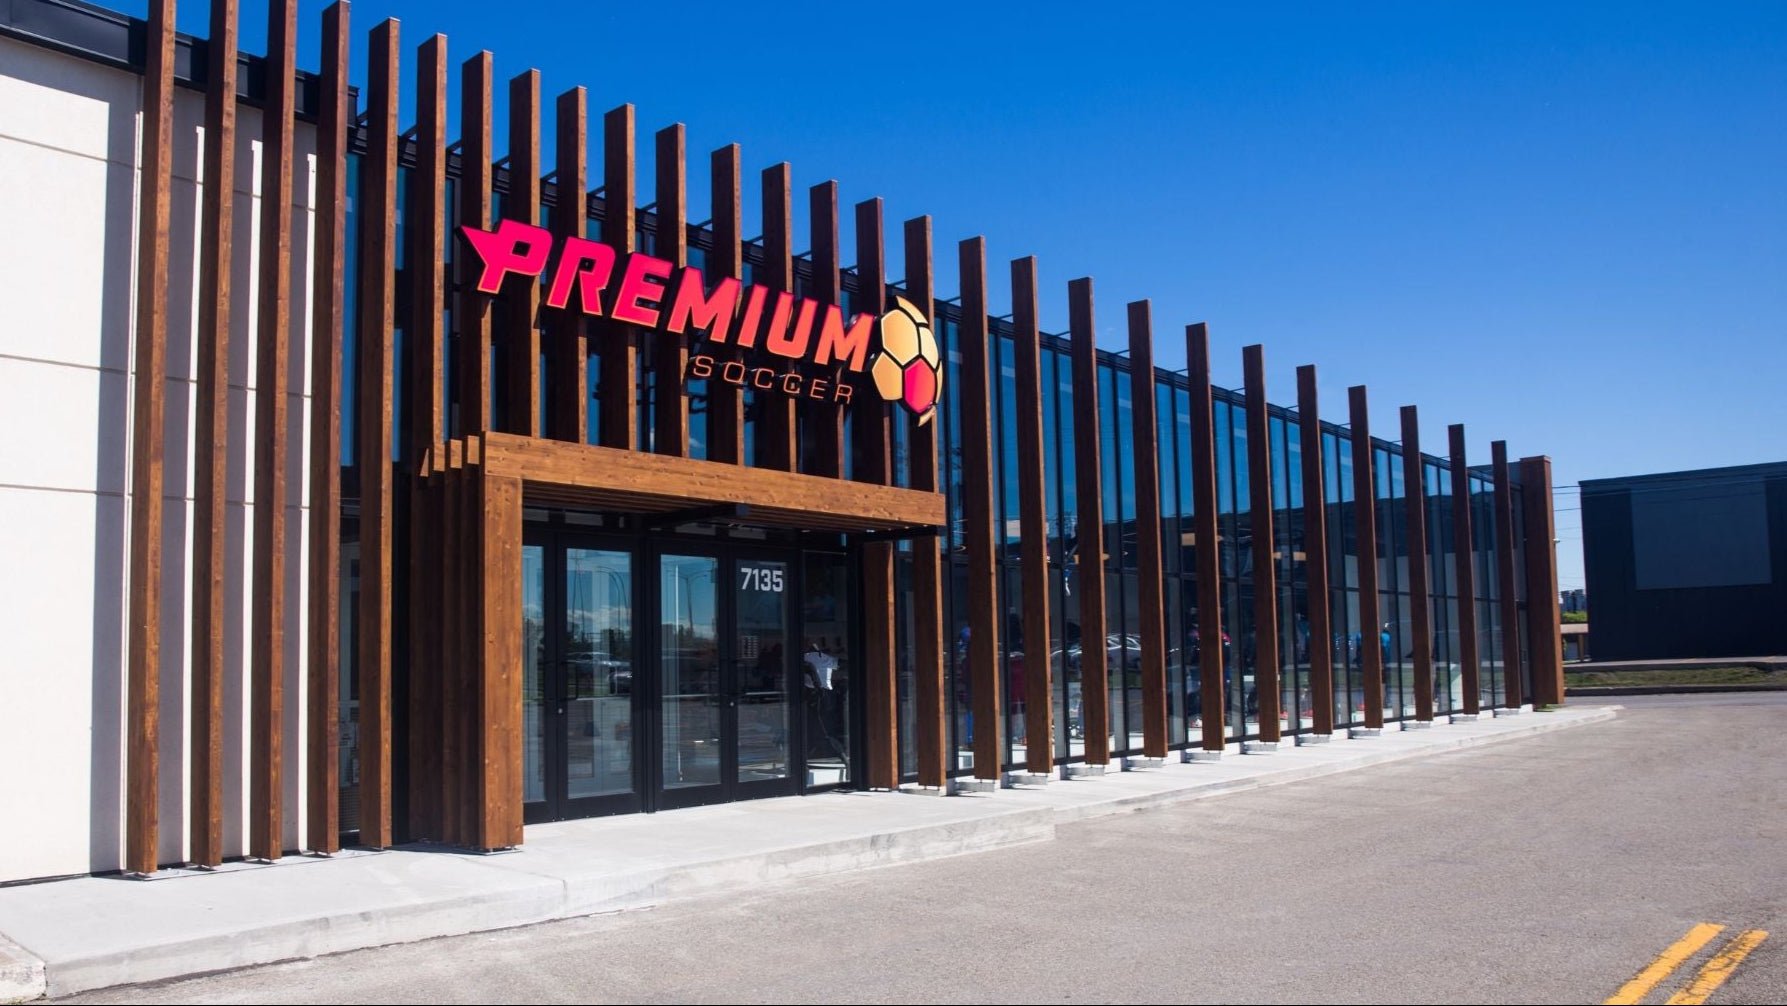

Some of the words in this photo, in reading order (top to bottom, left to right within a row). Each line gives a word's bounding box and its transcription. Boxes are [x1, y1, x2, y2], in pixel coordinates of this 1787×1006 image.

[461, 219, 874, 372] PREMIUM
[693, 355, 853, 404] SOCCER
[741, 568, 783, 592] 7135
